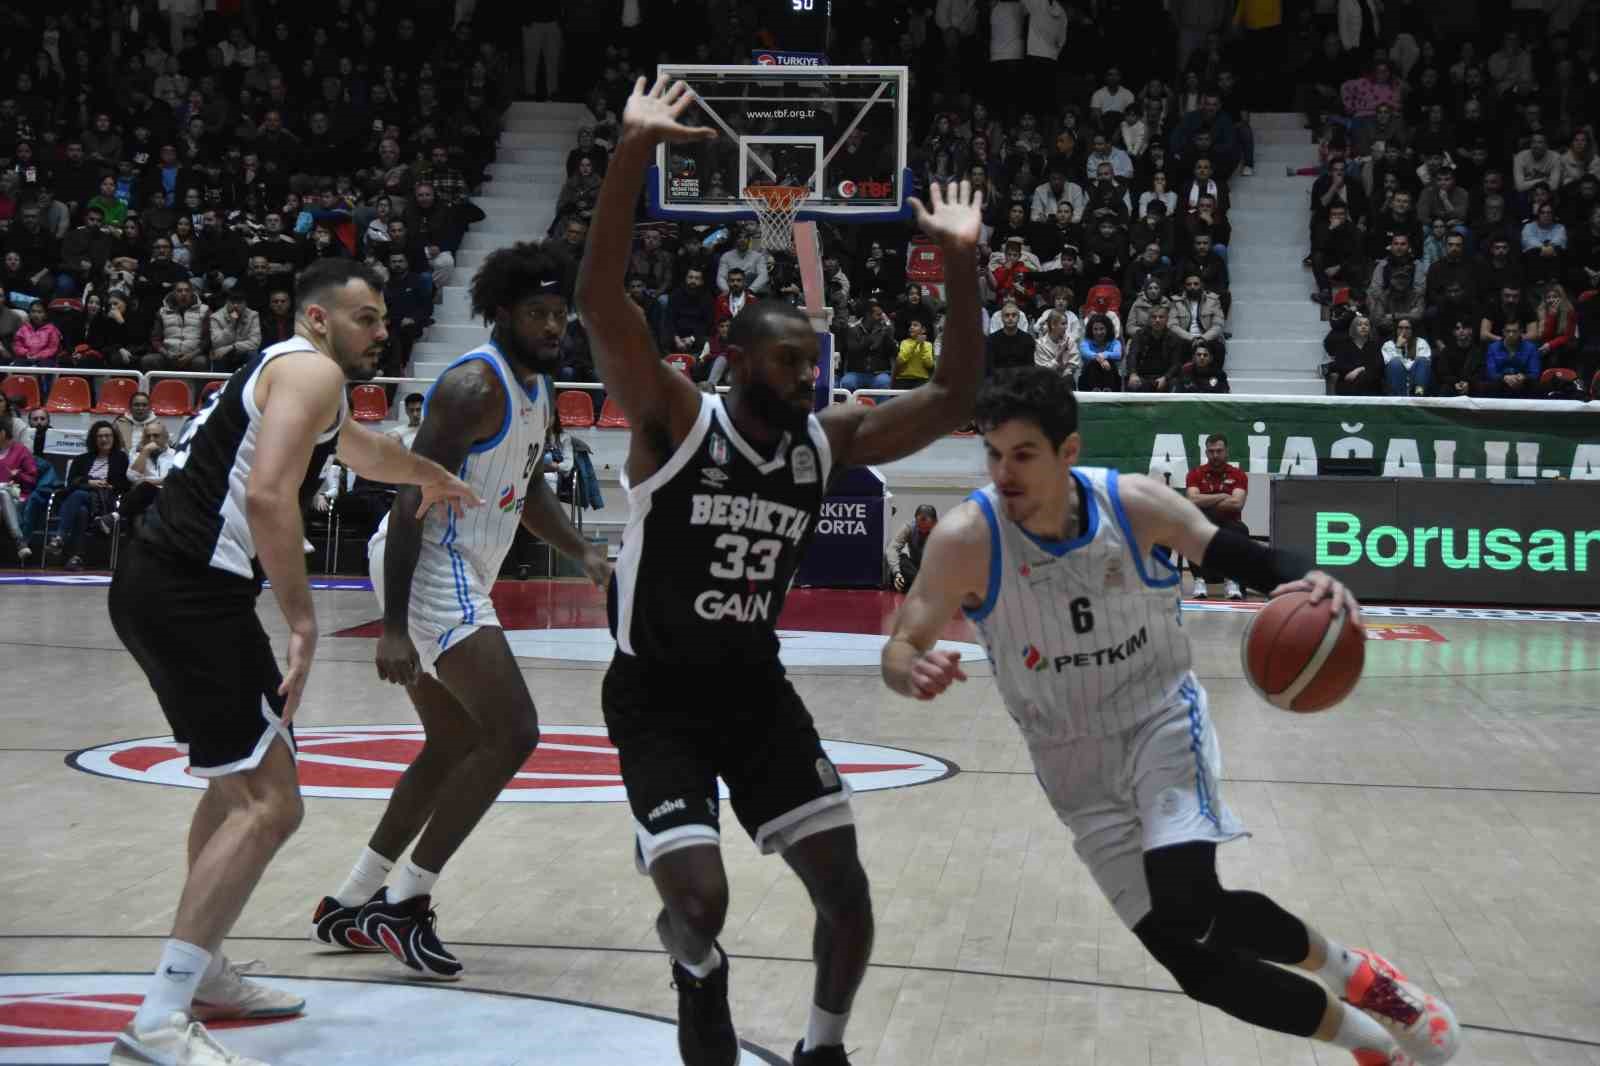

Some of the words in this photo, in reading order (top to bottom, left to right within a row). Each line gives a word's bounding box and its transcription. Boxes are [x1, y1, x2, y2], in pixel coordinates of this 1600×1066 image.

[746, 108, 816, 121] www.tbf.org.tr
[709, 533, 783, 580] 33
[1069, 596, 1095, 635] 6
[1054, 626, 1148, 673] PETKIM
